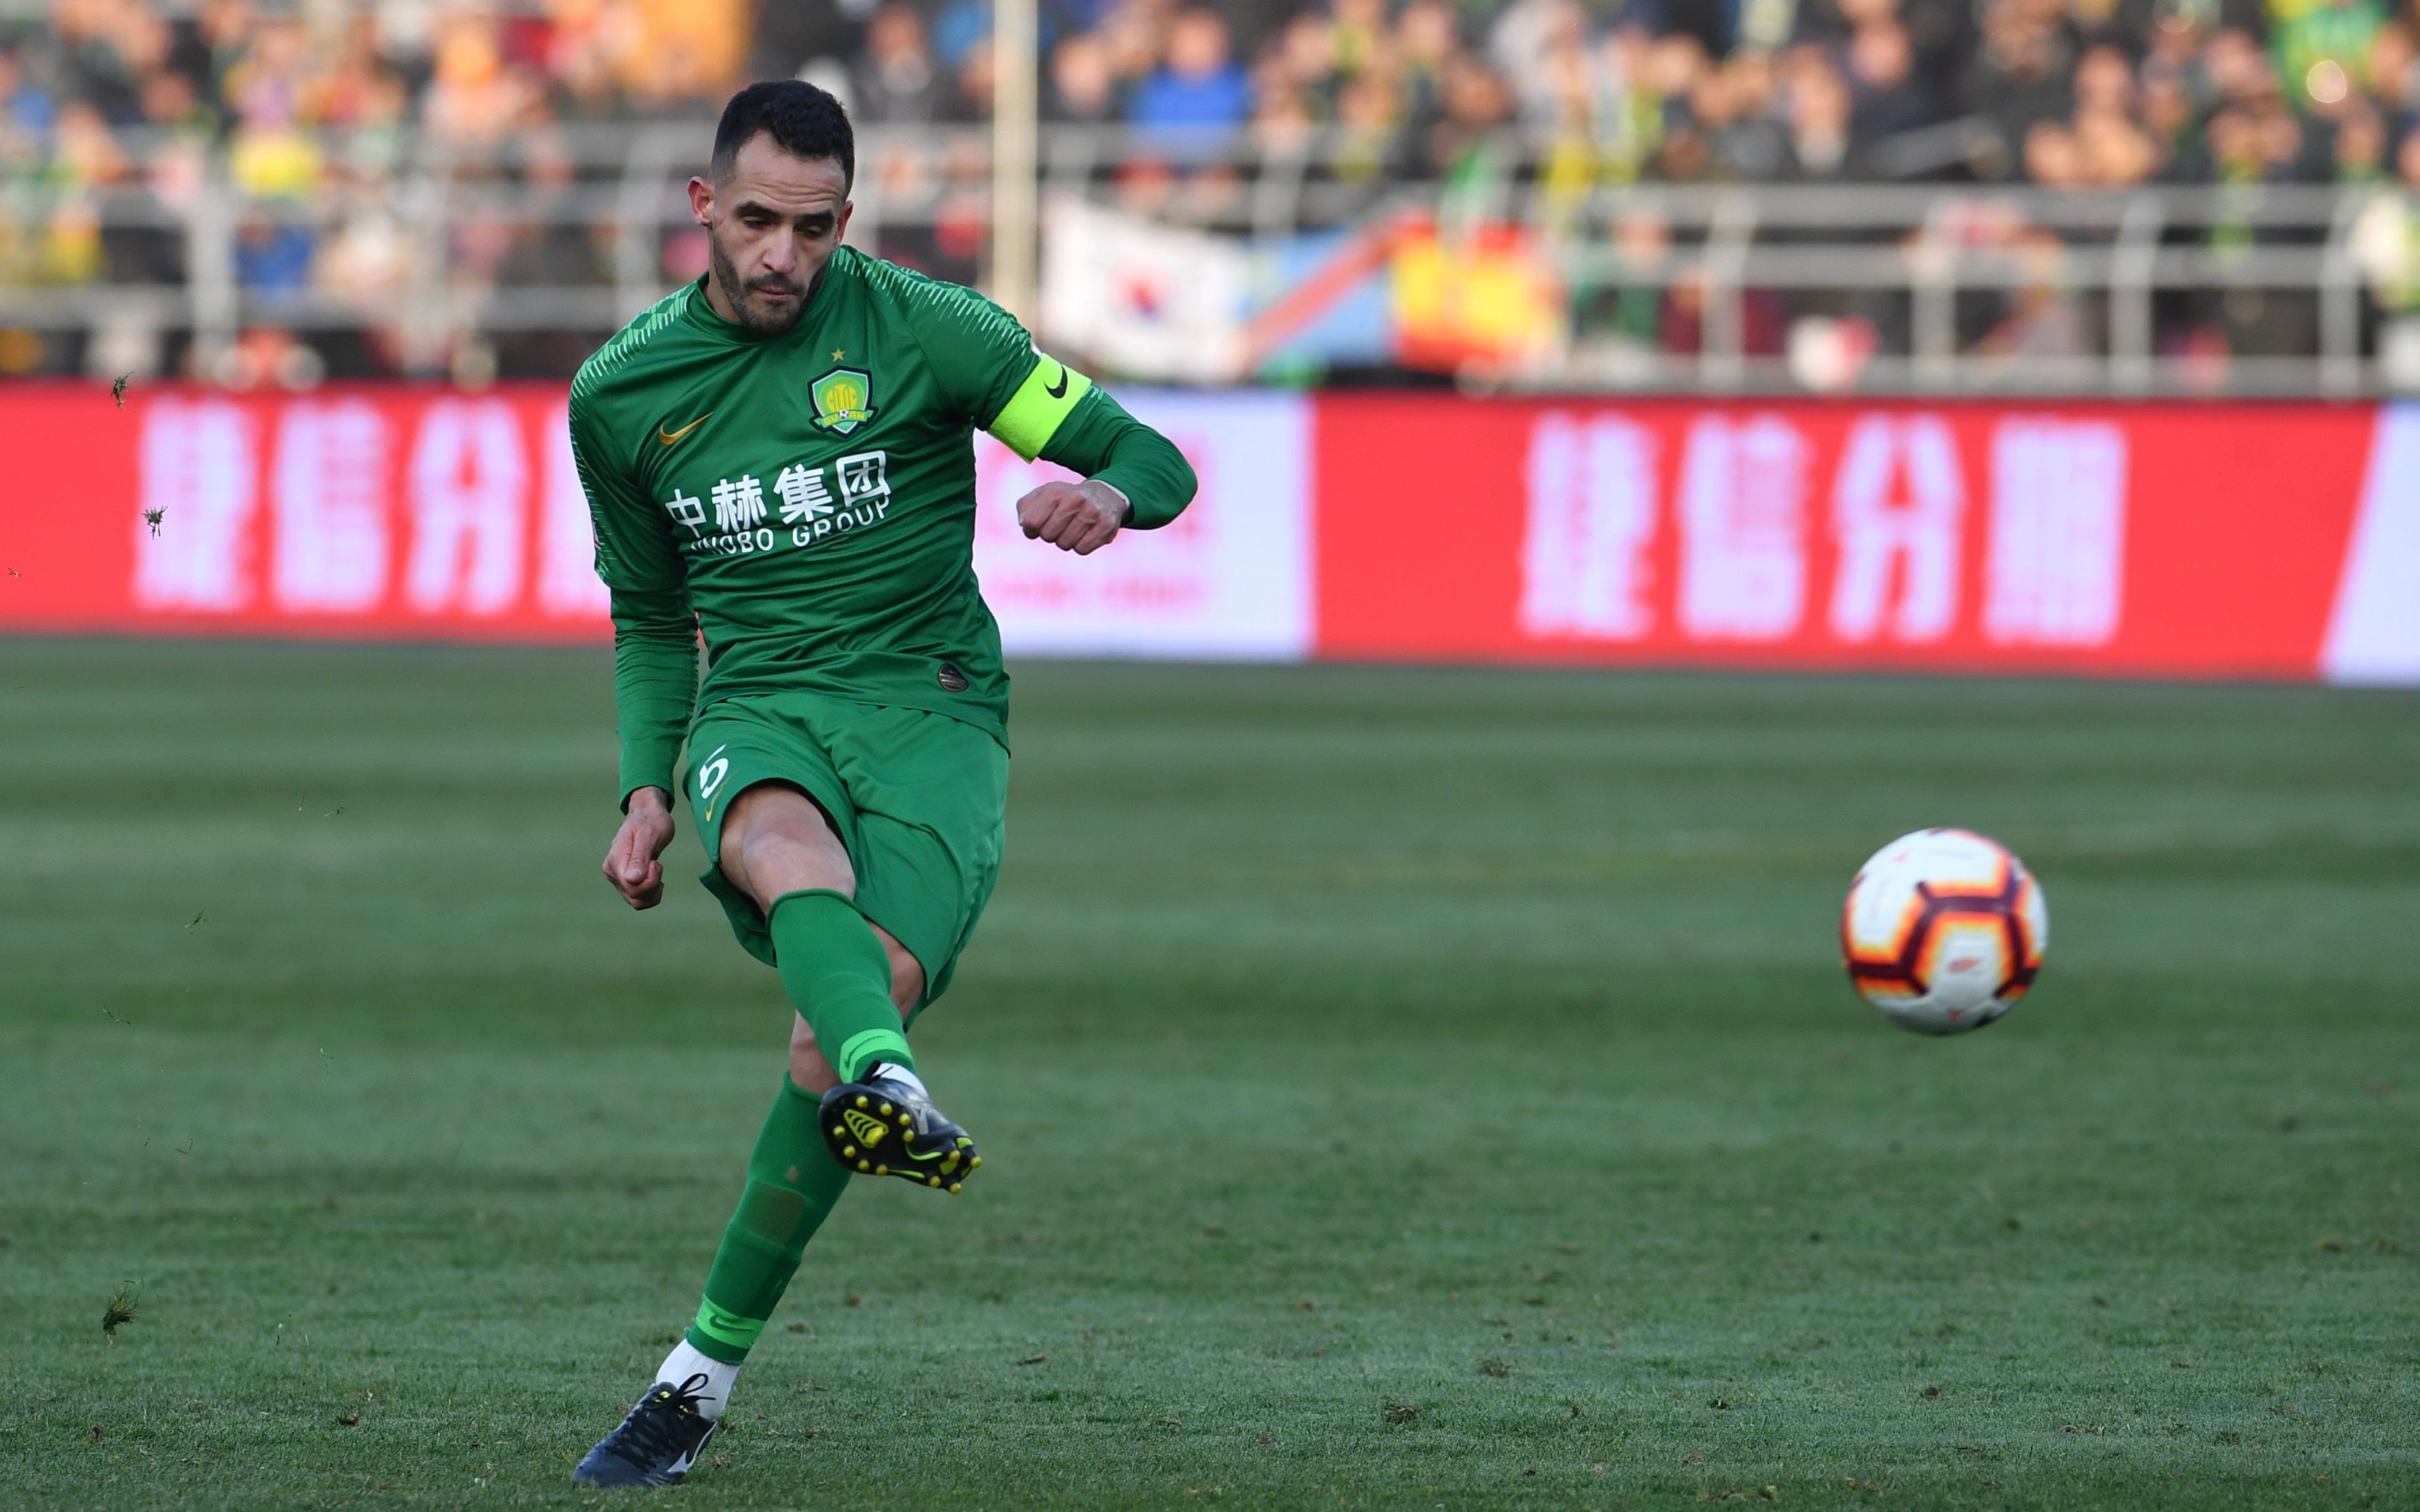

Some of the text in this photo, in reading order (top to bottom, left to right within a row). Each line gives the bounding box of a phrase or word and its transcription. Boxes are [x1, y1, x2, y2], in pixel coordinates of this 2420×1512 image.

[823, 410, 866, 426] GUAN
[665, 450, 891, 539] 中赫集团
[792, 494, 890, 547] GROUP
